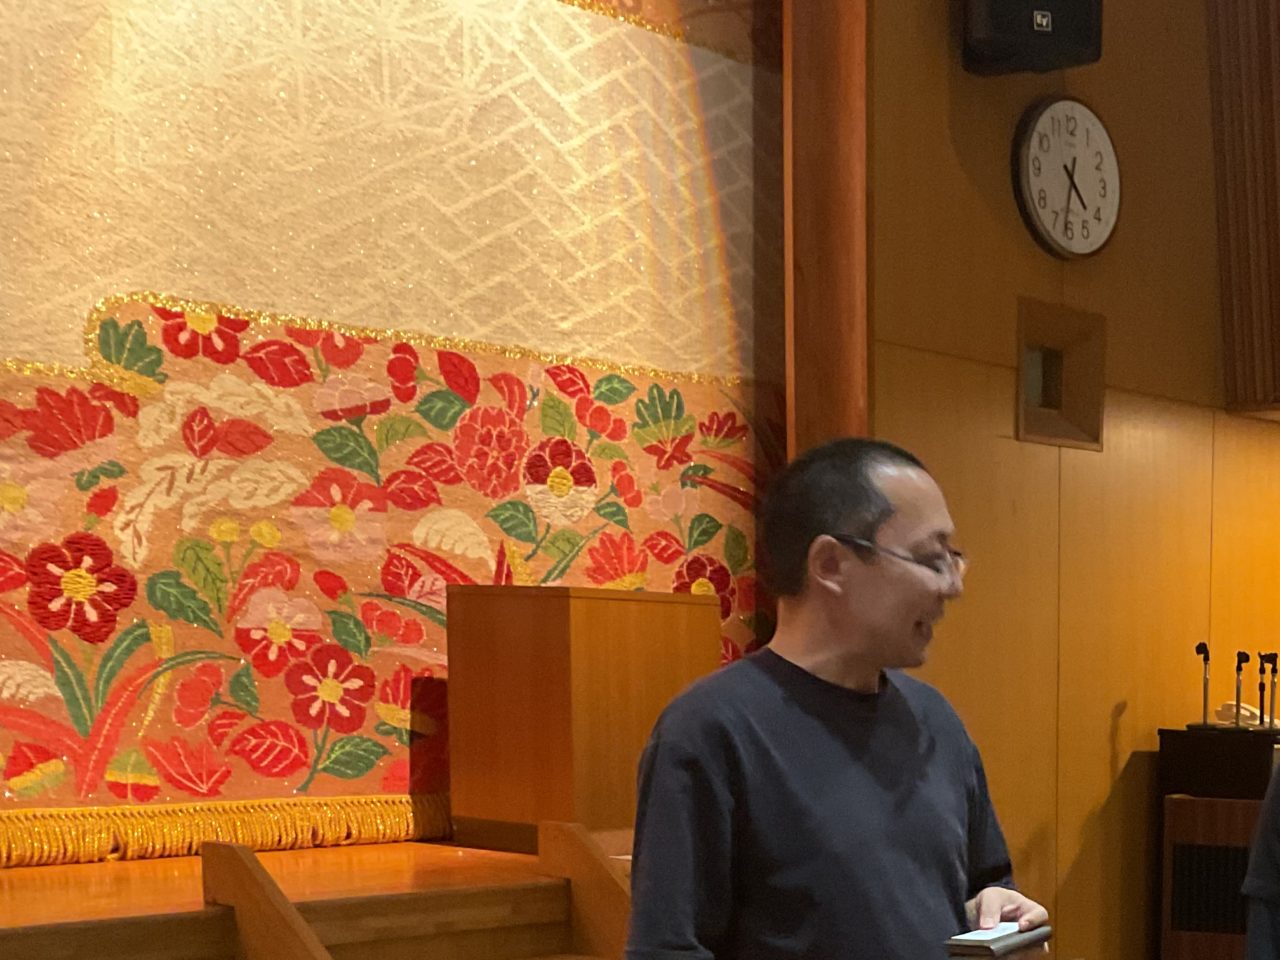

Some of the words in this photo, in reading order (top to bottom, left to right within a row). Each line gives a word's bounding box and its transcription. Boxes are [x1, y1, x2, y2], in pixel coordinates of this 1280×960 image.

[1051, 116, 1062, 138] 11
[1065, 114, 1078, 137] 12
[1038, 131, 1050, 153] 10
[1032, 156, 1042, 178] 9
[1095, 151, 1104, 171] 2
[1038, 189, 1047, 209] 8
[1099, 178, 1107, 199] 3
[1051, 210, 1060, 231] 7
[1093, 206, 1102, 223] 4
[1081, 219, 1090, 240] 5
